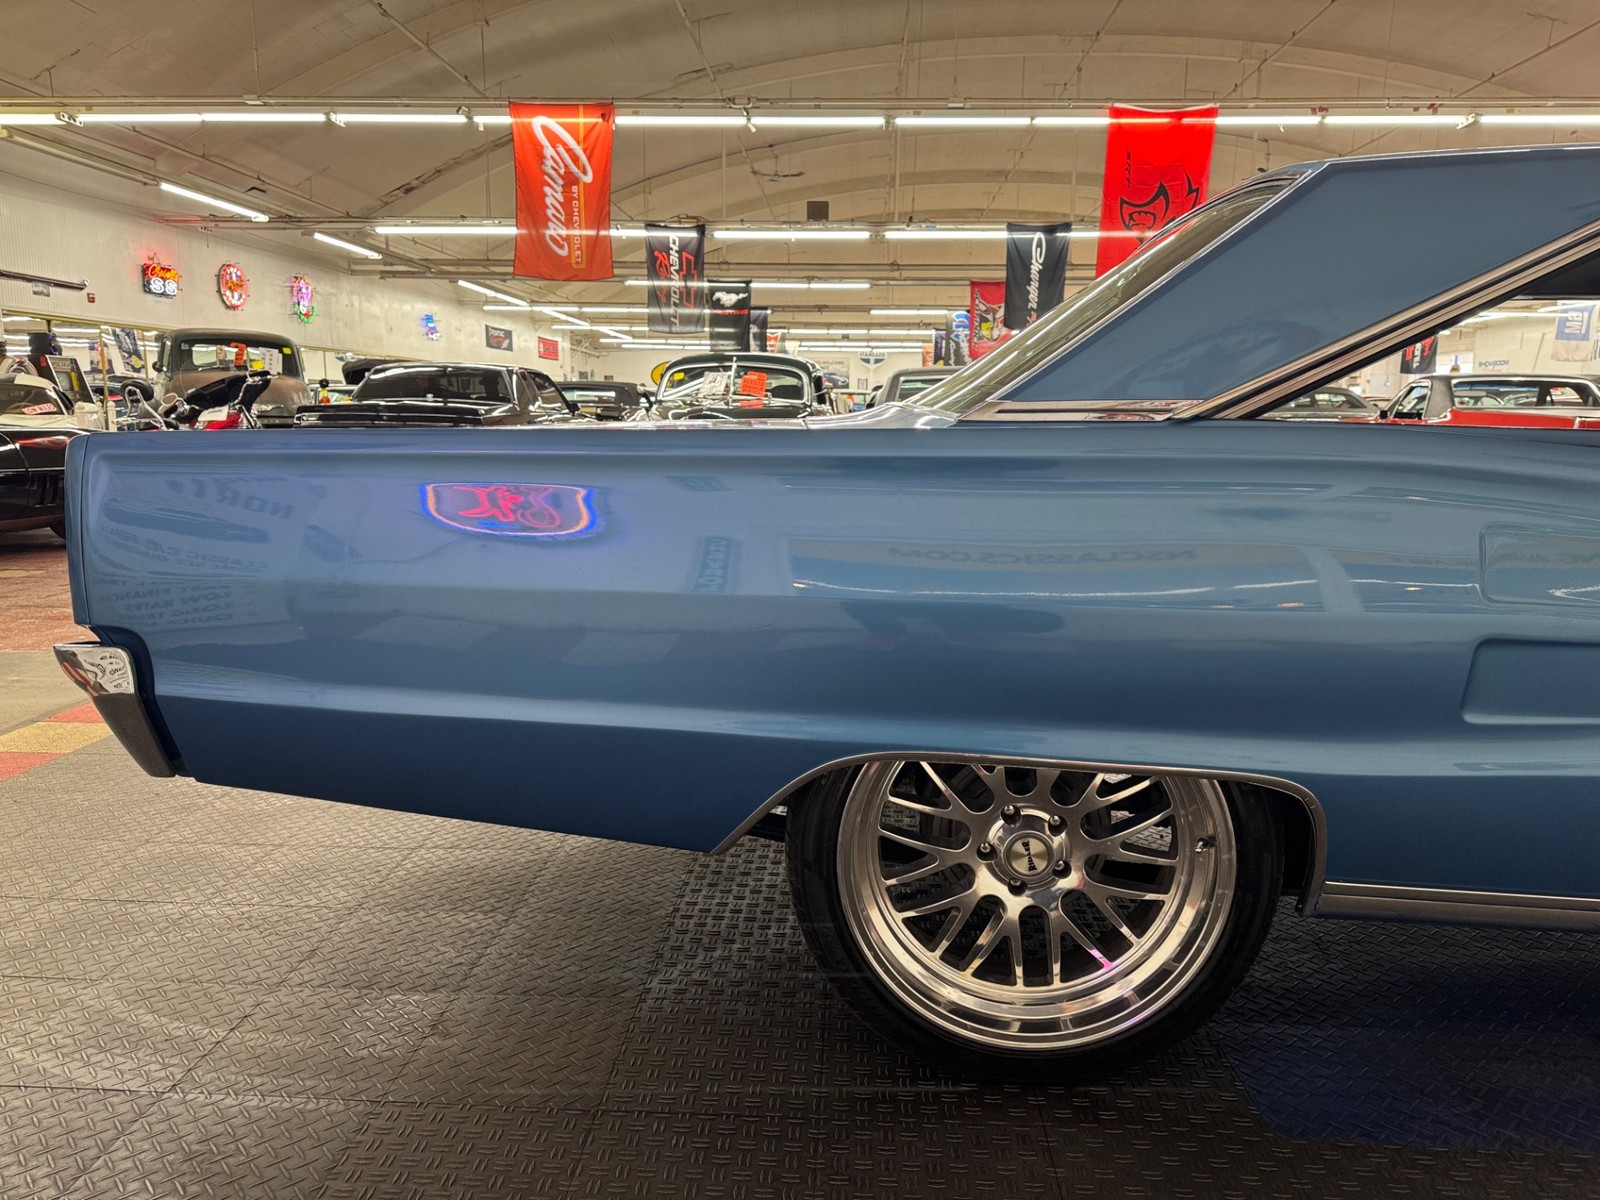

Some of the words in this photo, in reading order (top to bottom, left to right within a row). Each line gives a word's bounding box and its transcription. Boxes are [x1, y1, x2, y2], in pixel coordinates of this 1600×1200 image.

[531, 115, 593, 257] Camaro
[571, 185, 579, 199] BY
[571, 201, 582, 264] CHEVROLET
[150, 278, 177, 295] SS
[669, 234, 680, 327] CHEVROLET
[1026, 231, 1046, 309] Charger
[1022, 840, 1038, 872] RIDLER
